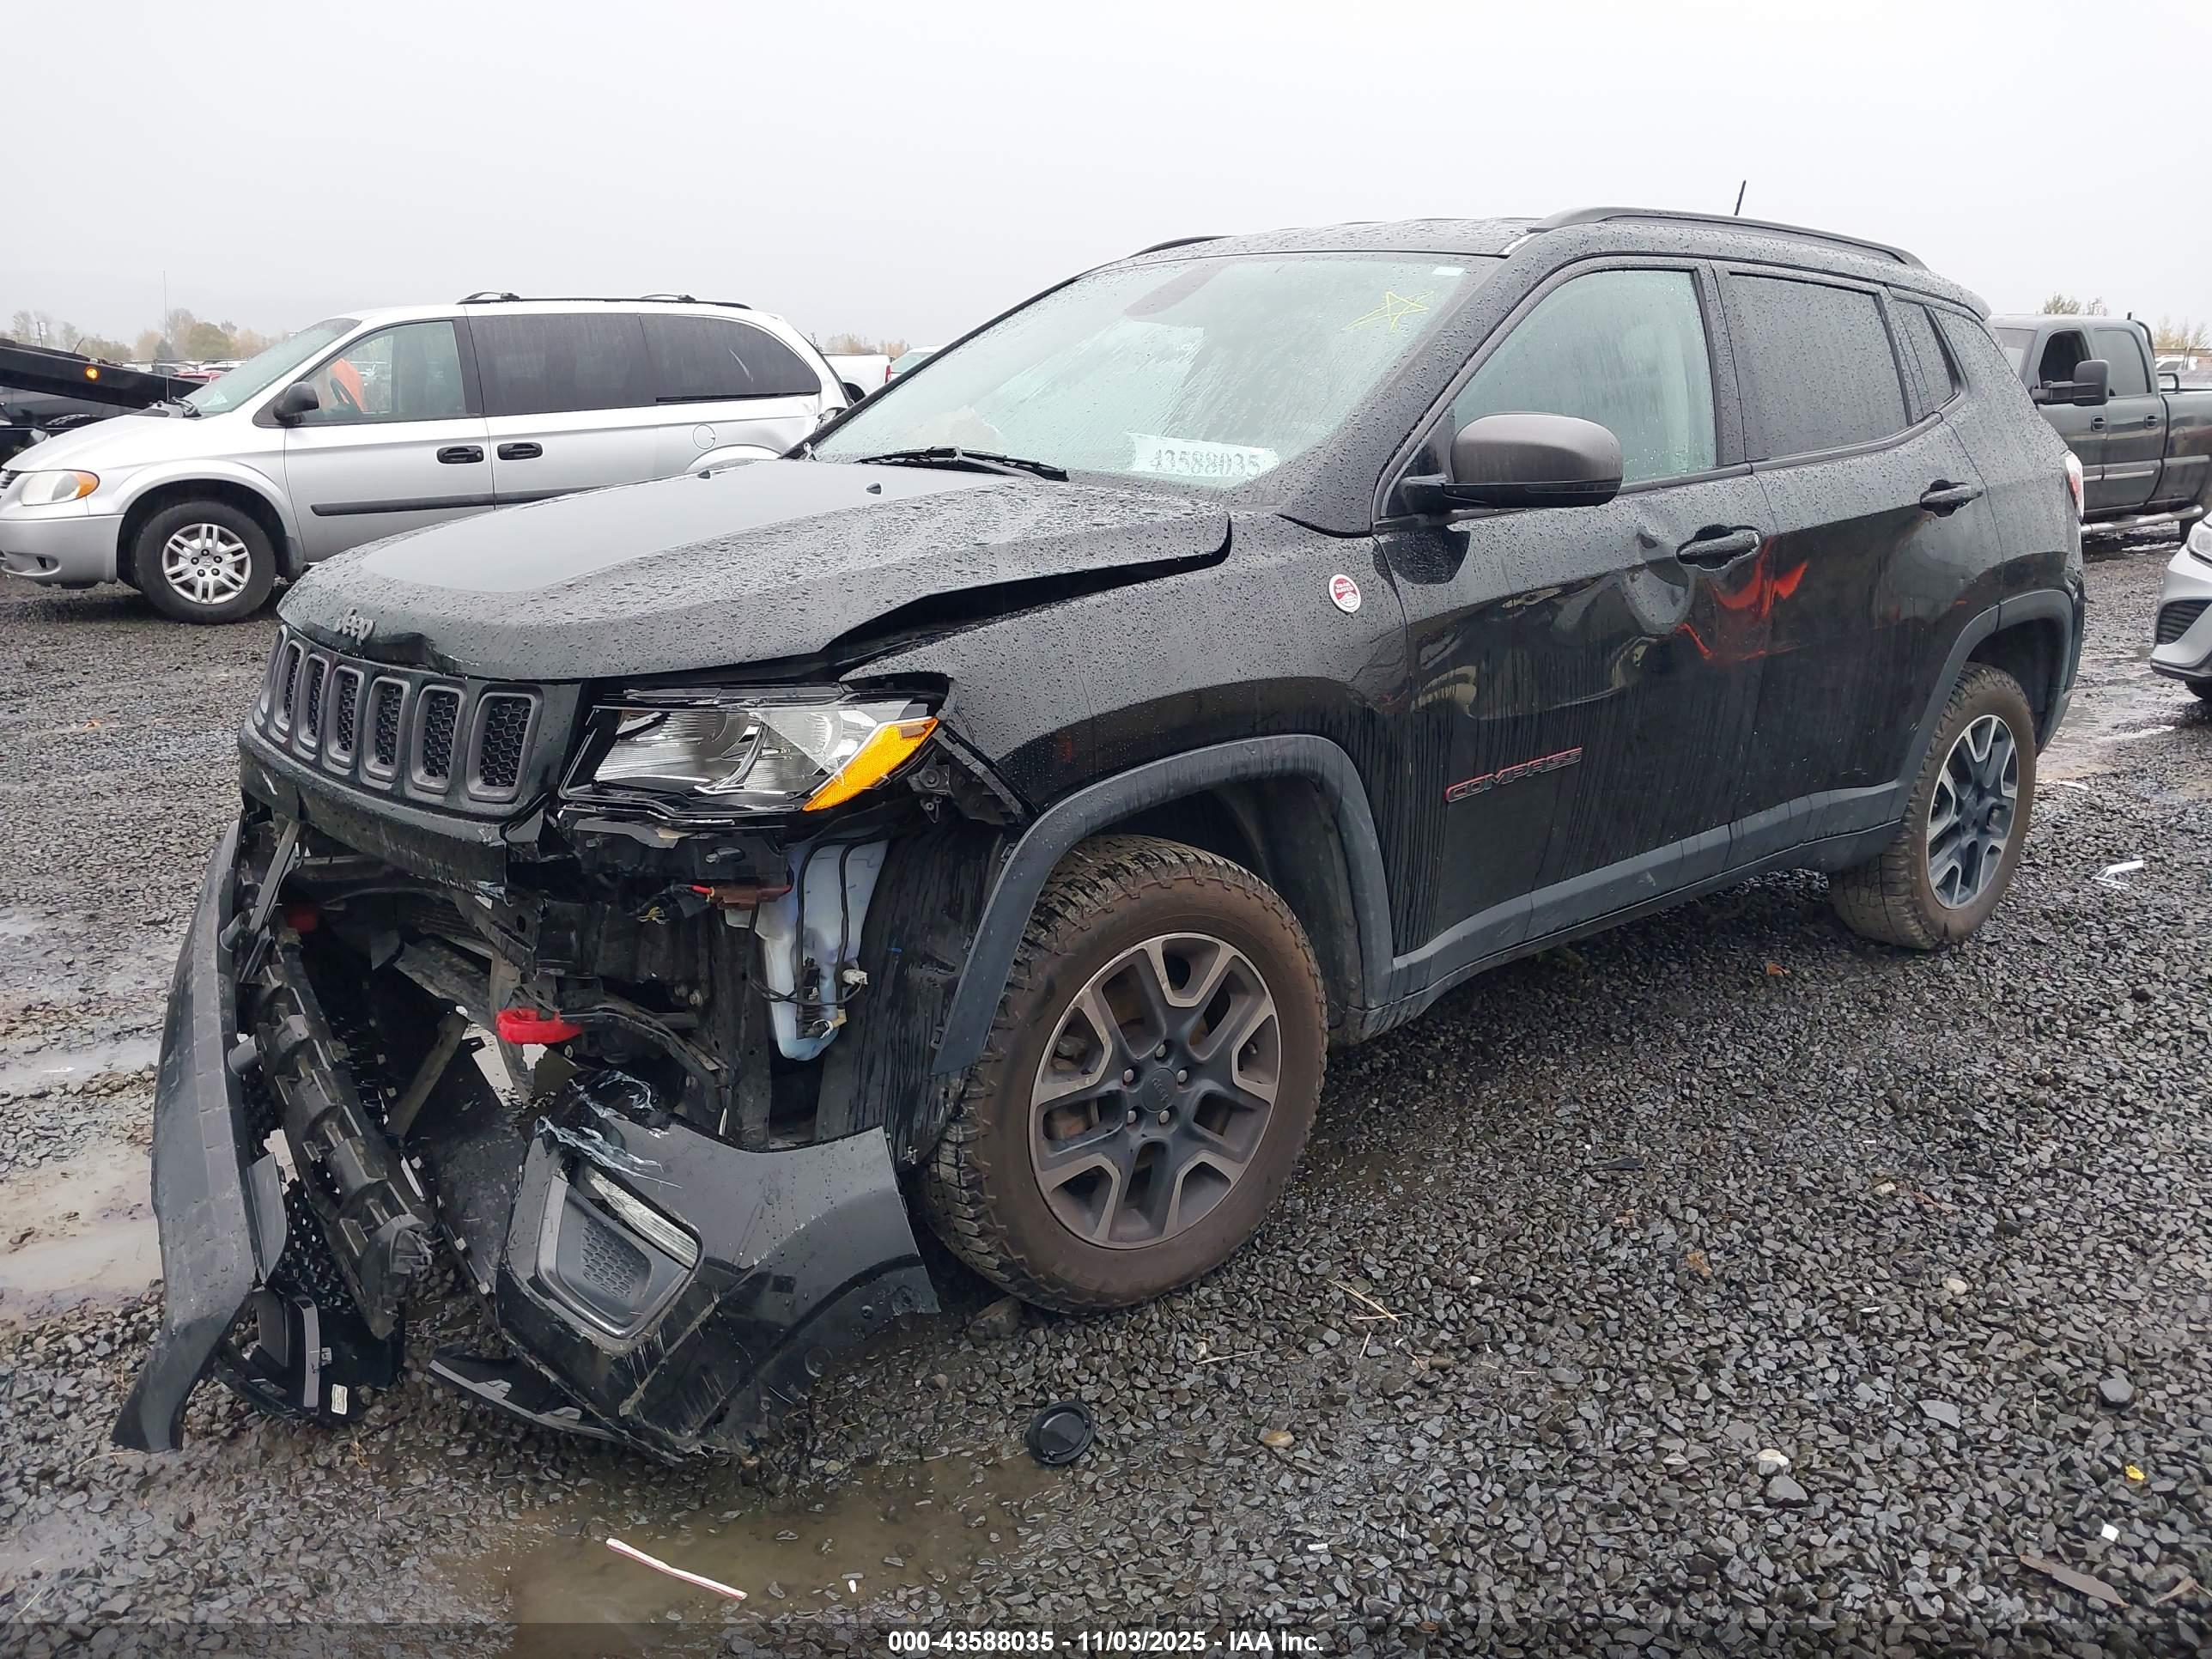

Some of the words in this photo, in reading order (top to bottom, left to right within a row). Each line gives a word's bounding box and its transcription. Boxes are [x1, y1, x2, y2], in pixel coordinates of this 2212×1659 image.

[1150, 448, 1261, 477] 43588035
[334, 606, 375, 646] Jeep
[1444, 747, 1583, 803] COMPASS
